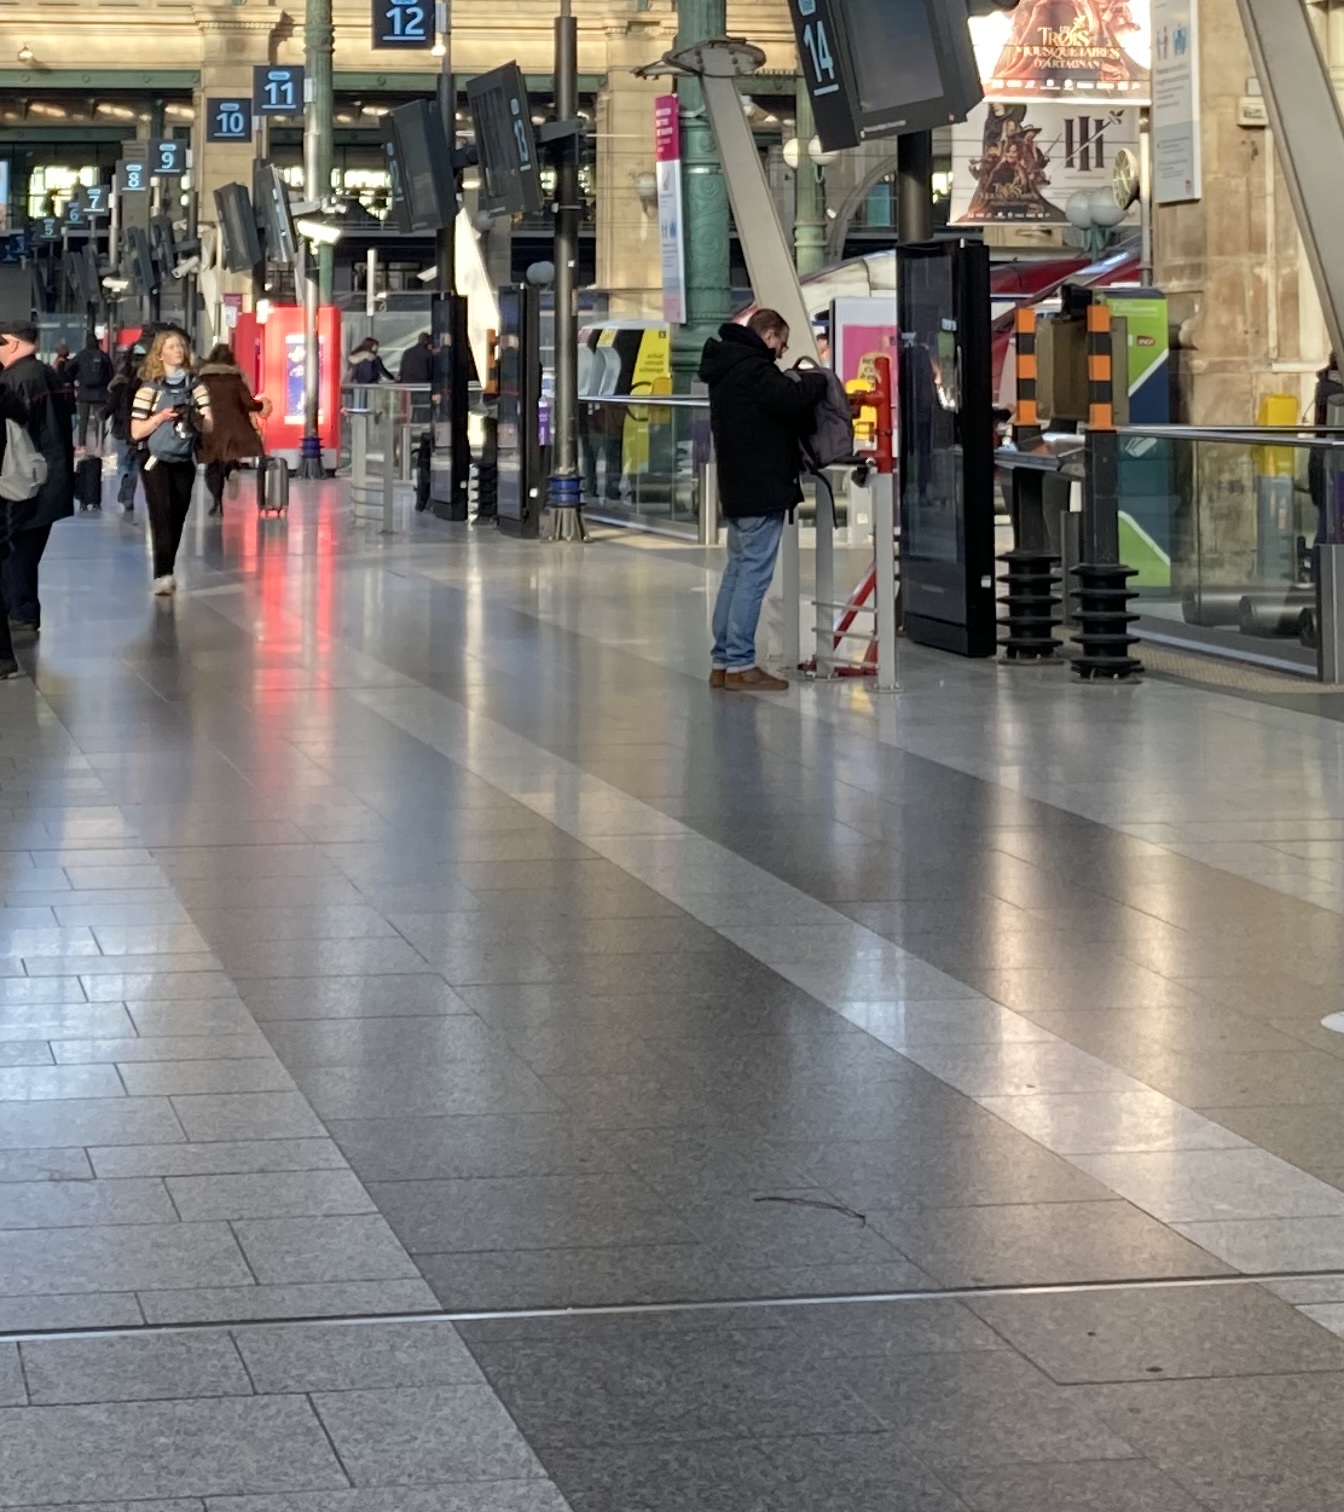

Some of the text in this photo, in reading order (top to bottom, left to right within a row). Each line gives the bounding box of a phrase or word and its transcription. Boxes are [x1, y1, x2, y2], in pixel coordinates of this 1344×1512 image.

[385, 6, 424, 36] 12
[803, 20, 835, 83] 14
[264, 82, 295, 105] 11
[216, 113, 244, 133] 10
[161, 152, 174, 169] 9
[127, 172, 140, 188] 8
[88, 195, 100, 209] 7
[69, 209, 79, 221] 6
[44, 224, 53, 235] 5
